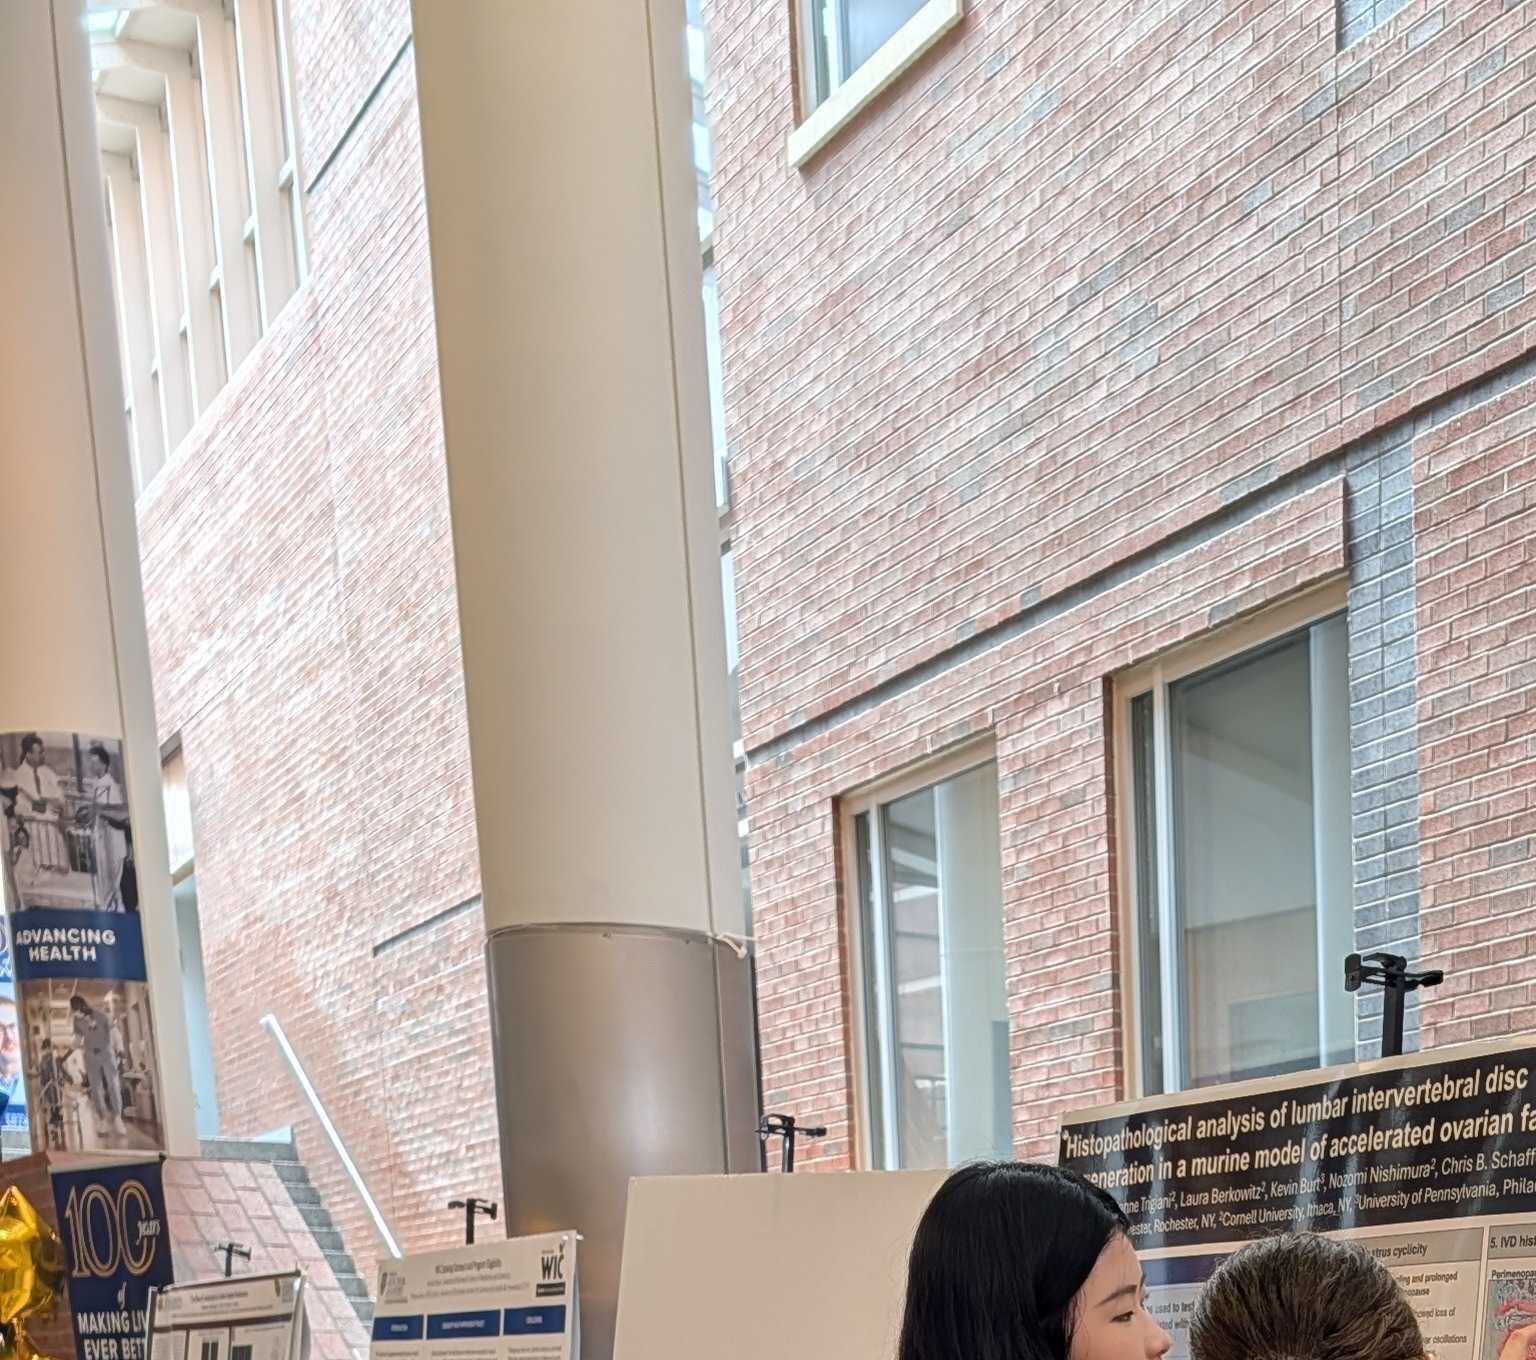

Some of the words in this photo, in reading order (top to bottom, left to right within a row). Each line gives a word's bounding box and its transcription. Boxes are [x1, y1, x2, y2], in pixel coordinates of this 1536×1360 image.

[16, 928, 115, 945] ADVANCING
[28, 947, 96, 962] HEALTH
[1062, 1115, 1193, 1160] Histopathological
[1196, 1106, 1265, 1141] analysis
[1269, 1100, 1289, 1129] of
[1291, 1094, 1349, 1126] lumbar
[1351, 1068, 1481, 1115] intervertebral
[1485, 1063, 1529, 1094] disc
[1158, 1155, 1172, 1180] in
[1176, 1159, 1187, 1178] a
[1191, 1147, 1250, 1177] murine
[1254, 1137, 1306, 1169] model
[1310, 1133, 1328, 1161] of
[1329, 1116, 1436, 1158] accelerated
[1439, 1109, 1513, 1143] ovarian
[1179, 1191, 1210, 1208] Laura
[1270, 1178, 1299, 1198] Kevin
[1328, 1166, 1369, 1190] Nozomi
[1441, 1154, 1474, 1176] Chris
[1475, 1152, 1488, 1172] B.
[1153, 1216, 1200, 1235] Rochester,
[1200, 1212, 1217, 1229] NY,
[1258, 1205, 1305, 1224] University,
[1411, 1187, 1424, 1205] of
[1423, 1180, 1500, 1204] Pennsylvania,
[65, 1179, 157, 1278] 100
[1487, 1236, 1498, 1250] 5.
[1500, 1235, 1517, 1249] IVD
[541, 1253, 565, 1280] WIC
[78, 1311, 129, 1335] MAKING
[84, 1340, 118, 1360] EVER
